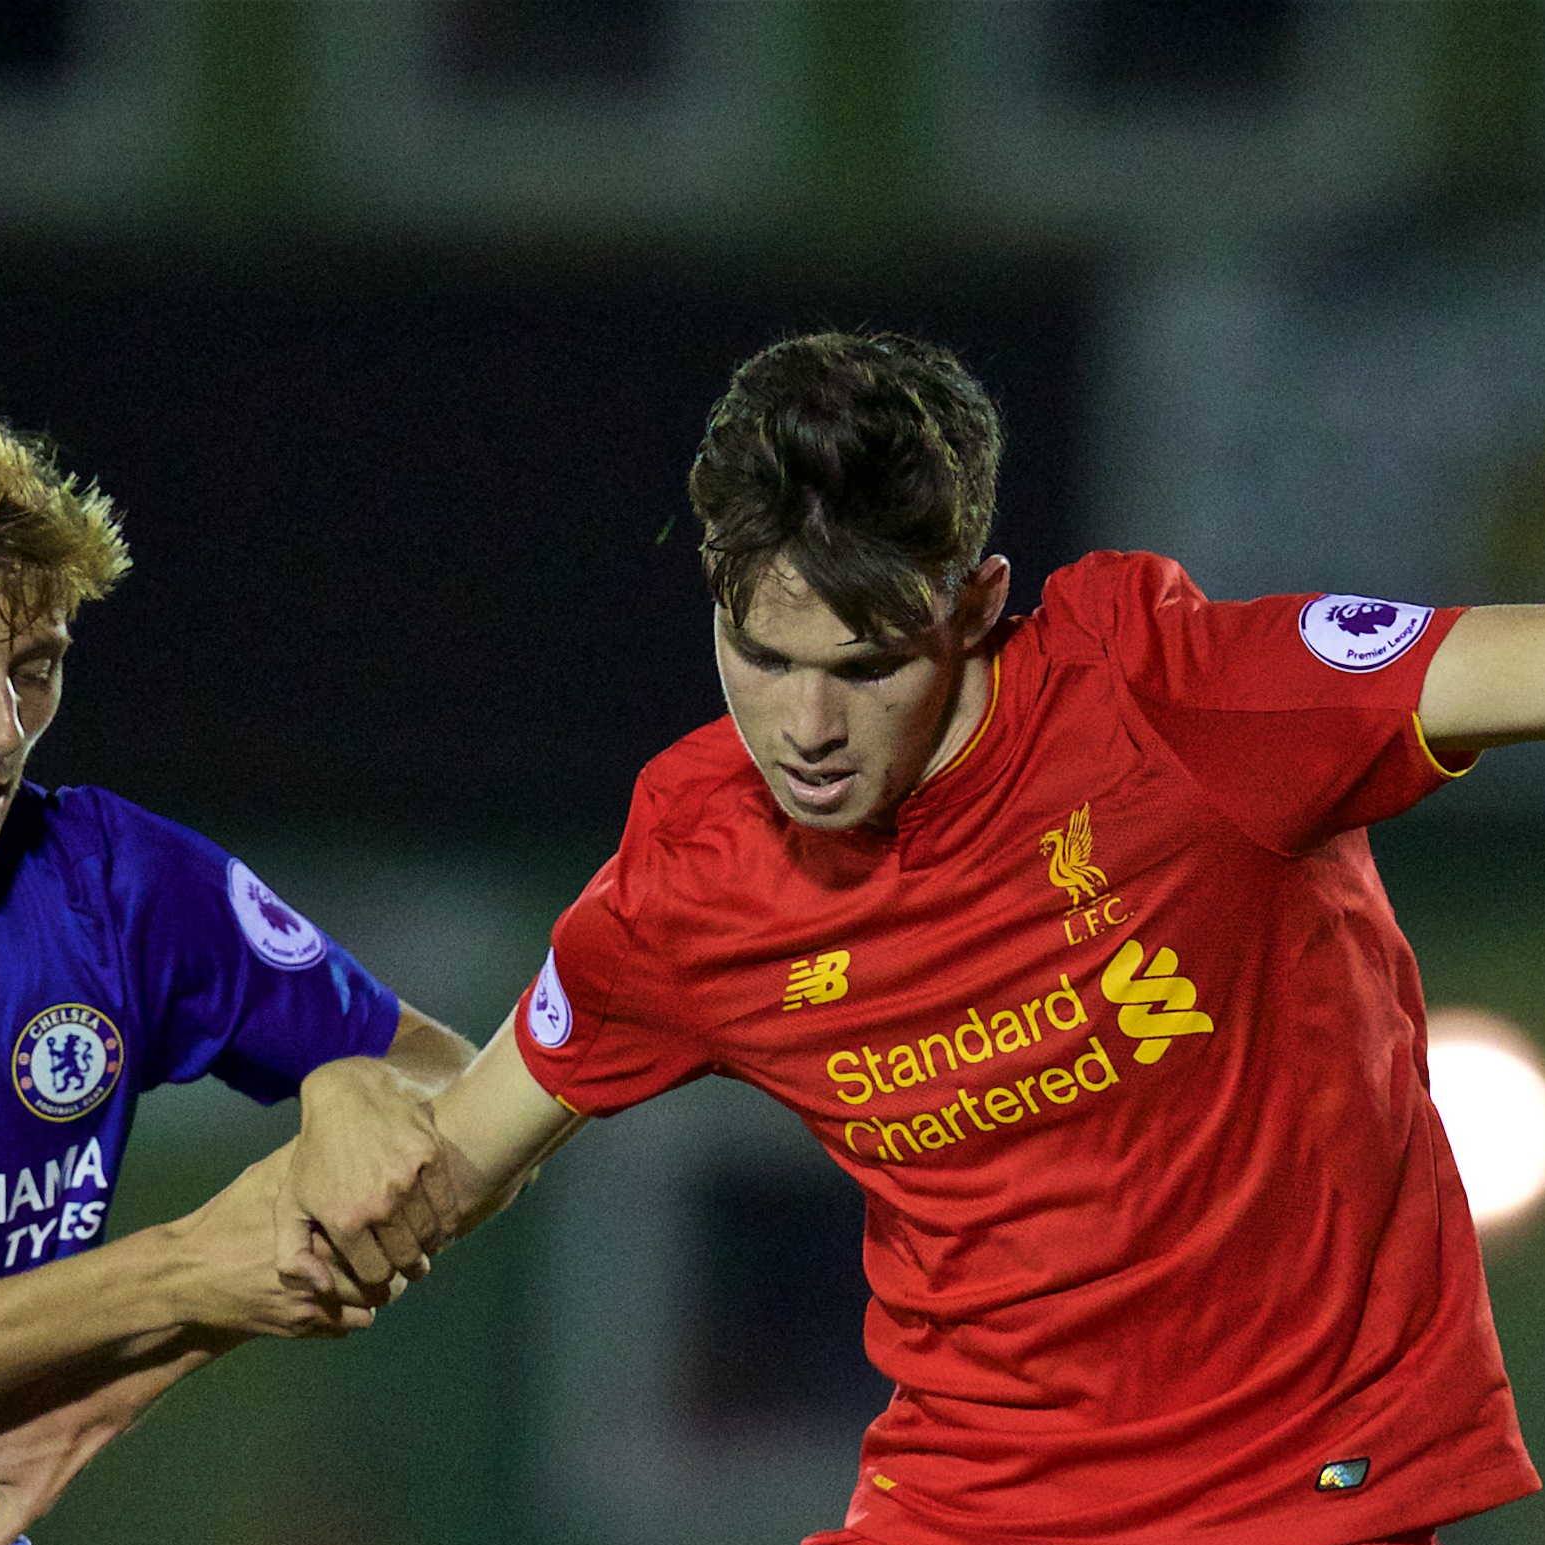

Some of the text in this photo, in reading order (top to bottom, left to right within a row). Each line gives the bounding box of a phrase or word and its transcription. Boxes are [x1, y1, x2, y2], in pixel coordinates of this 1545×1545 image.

[1347, 617, 1418, 660] Premier League
[30, 1009, 99, 1039] CHELSEA
[826, 973, 1089, 1105] Standard
[843, 1037, 1120, 1162] Chartered
